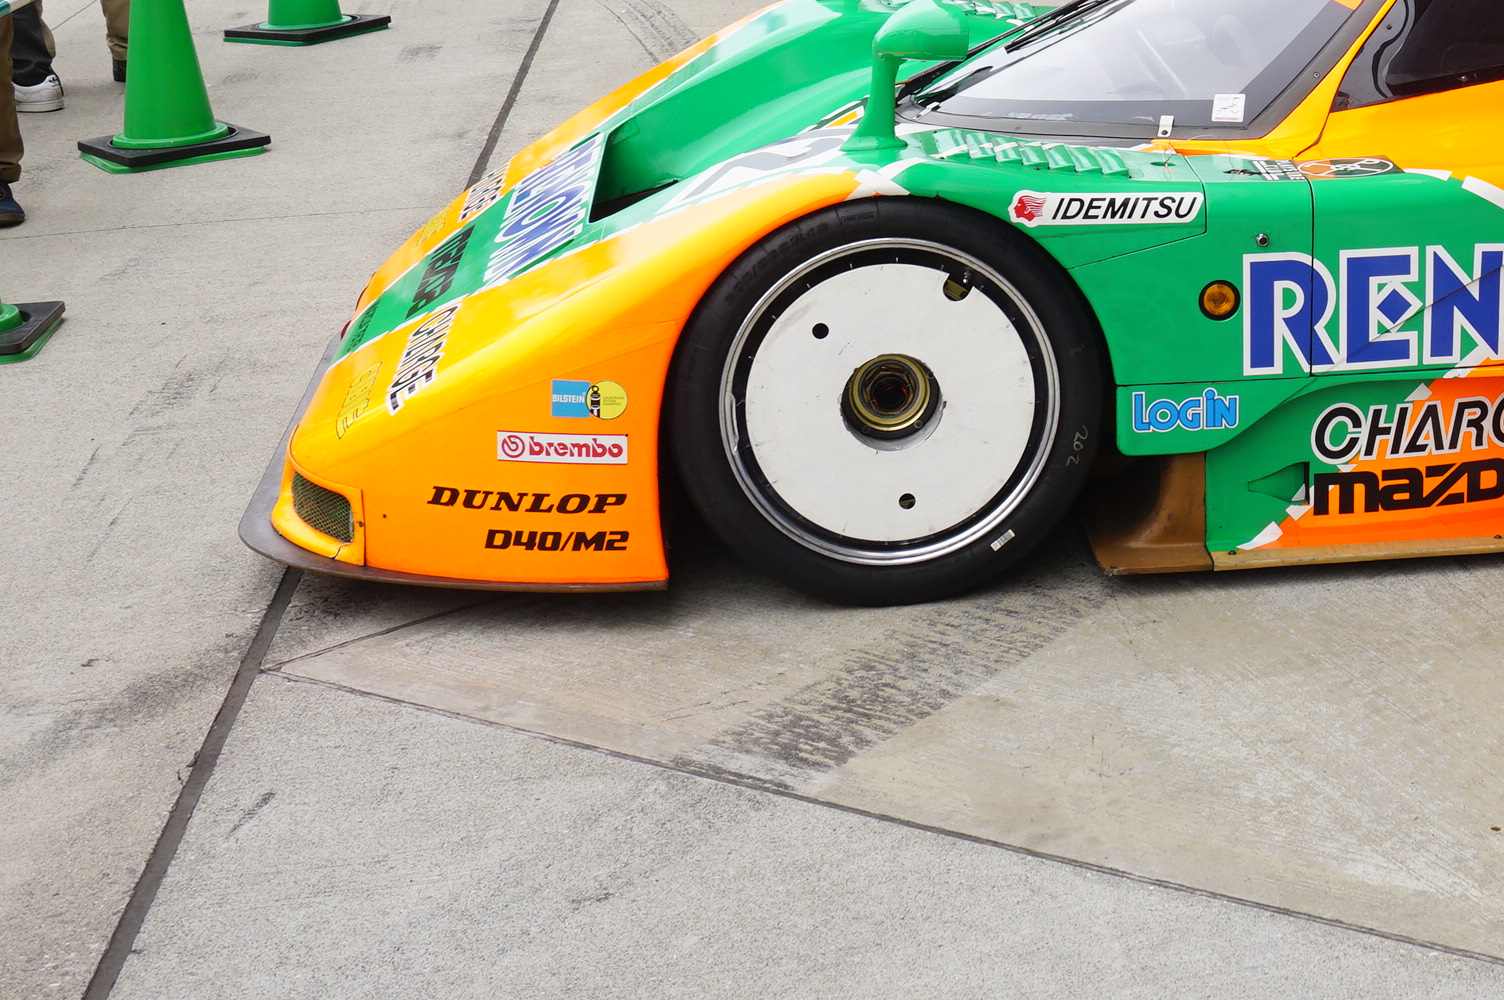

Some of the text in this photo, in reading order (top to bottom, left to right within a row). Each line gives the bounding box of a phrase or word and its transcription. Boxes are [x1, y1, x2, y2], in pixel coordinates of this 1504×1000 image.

[1051, 196, 1198, 221] IDEMITSU
[386, 301, 462, 416] CHARGE
[552, 393, 585, 404] BILSTEIN
[528, 436, 624, 459] brembo
[427, 486, 627, 514] DUNLOP
[484, 529, 630, 552] D40/M2
